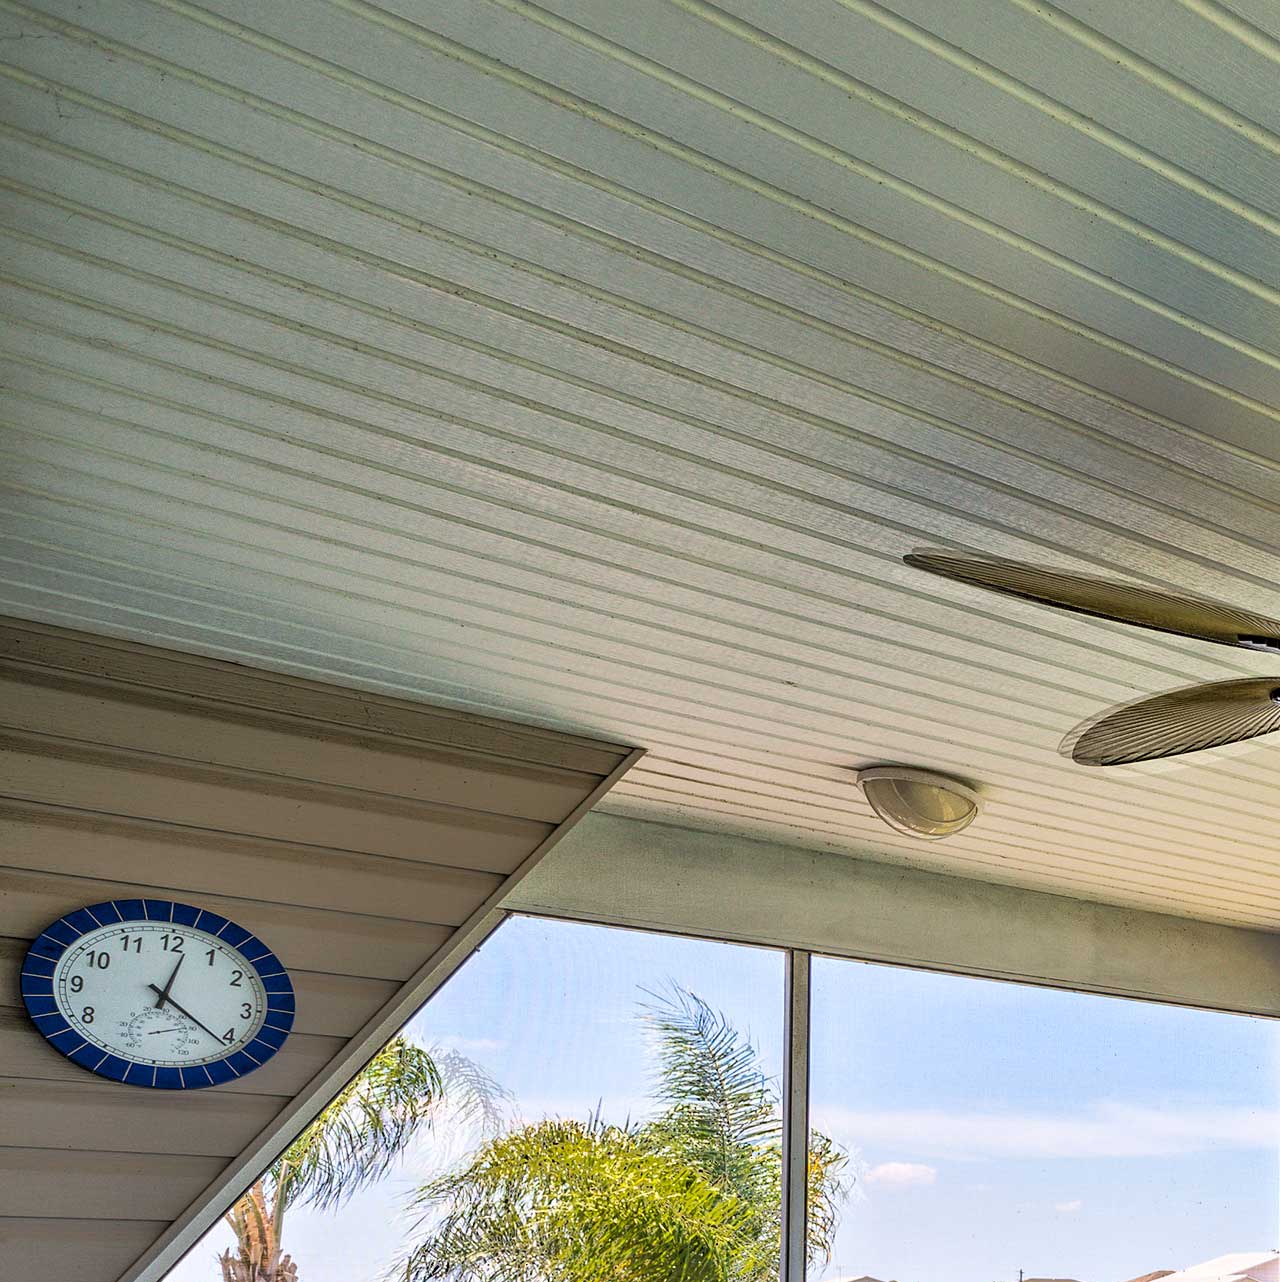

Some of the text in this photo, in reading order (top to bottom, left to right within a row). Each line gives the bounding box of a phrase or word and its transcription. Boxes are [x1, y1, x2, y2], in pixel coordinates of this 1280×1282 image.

[120, 934, 143, 954] 11
[160, 934, 184, 954] 12
[86, 950, 110, 970] 10
[205, 949, 216, 966] 1
[70, 975, 84, 993] 9
[229, 970, 243, 987] 2
[81, 1006, 95, 1023] 8
[240, 1002, 252, 1020] 3
[223, 1027, 235, 1045] 4
